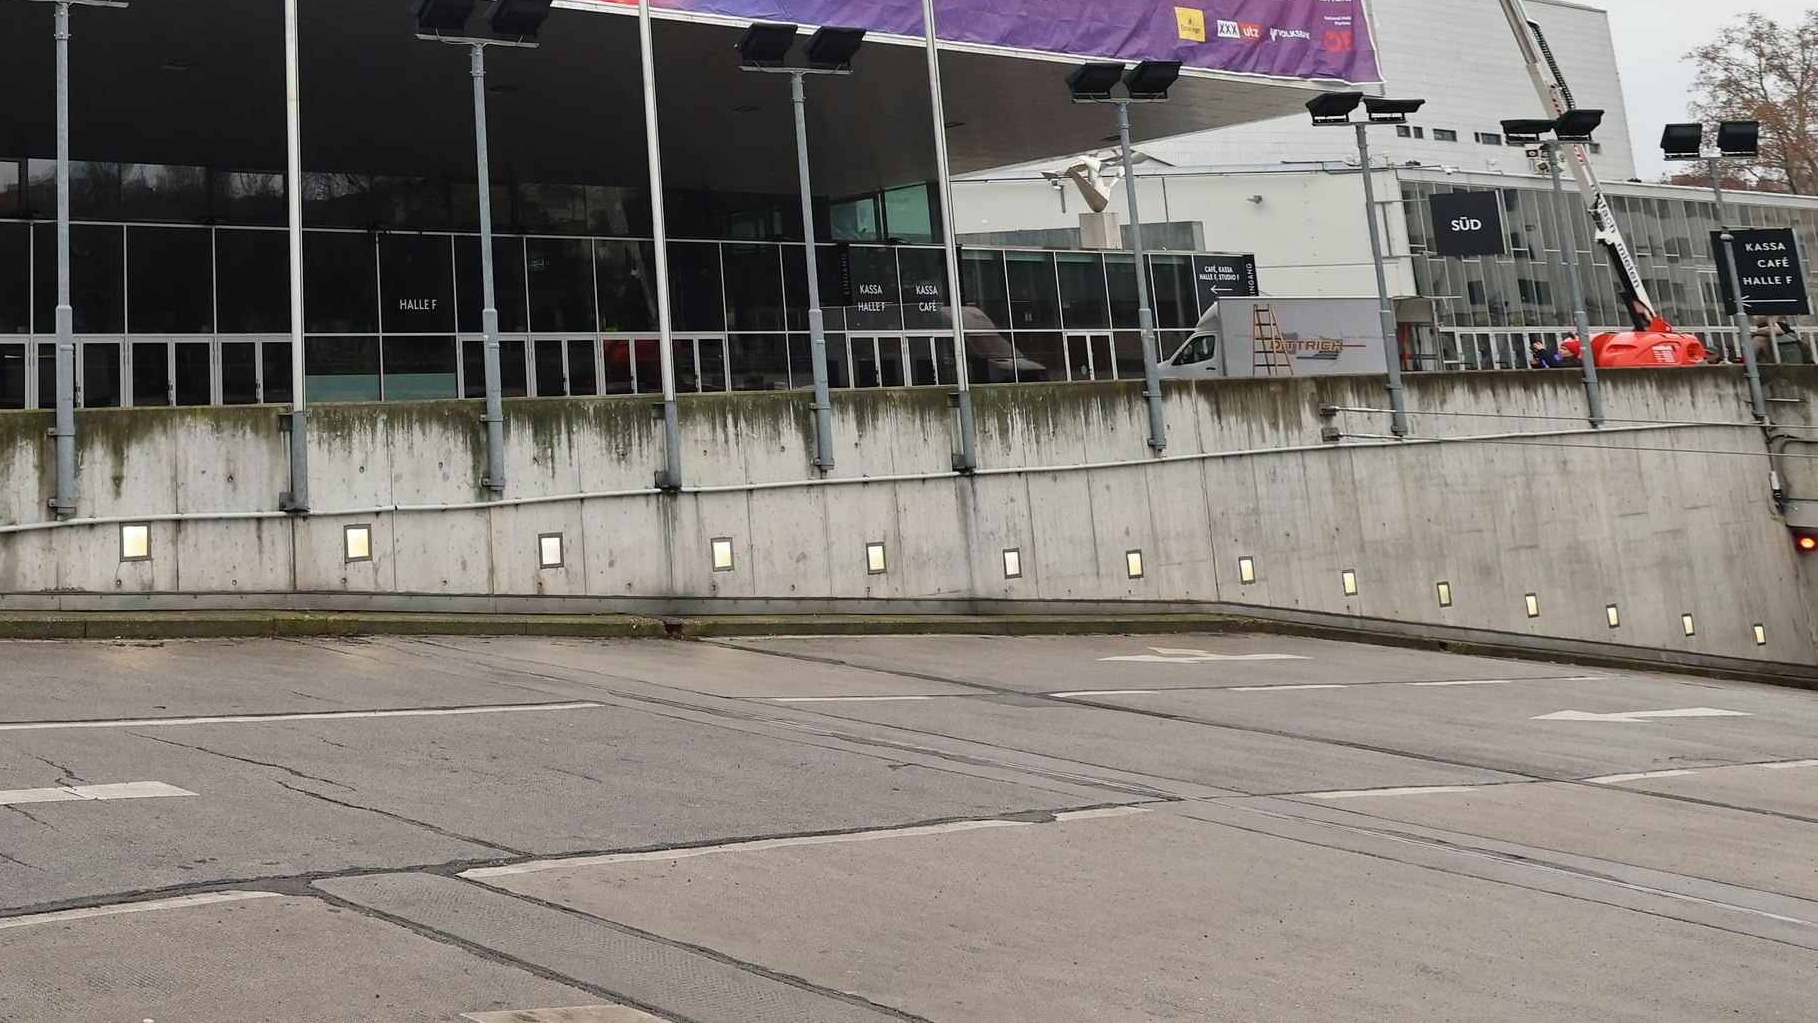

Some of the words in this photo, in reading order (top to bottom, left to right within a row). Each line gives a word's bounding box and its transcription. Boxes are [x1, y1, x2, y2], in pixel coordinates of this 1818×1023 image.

[1451, 216, 1482, 231] SÜD
[1745, 242, 1786, 251] KASSA
[1617, 243, 1640, 288] mieten
[1757, 257, 1790, 268] CAFÉ
[1246, 263, 1256, 297] INGANG
[1743, 276, 1782, 285] HALLE
[1785, 276, 1793, 284] F
[859, 285, 882, 294] KASSA
[916, 286, 938, 295] KASSA
[399, 299, 429, 310] HALLE
[432, 299, 437, 310] F
[858, 302, 881, 311] HALLE
[882, 302, 886, 311] F
[919, 300, 937, 312] CAFÉ
